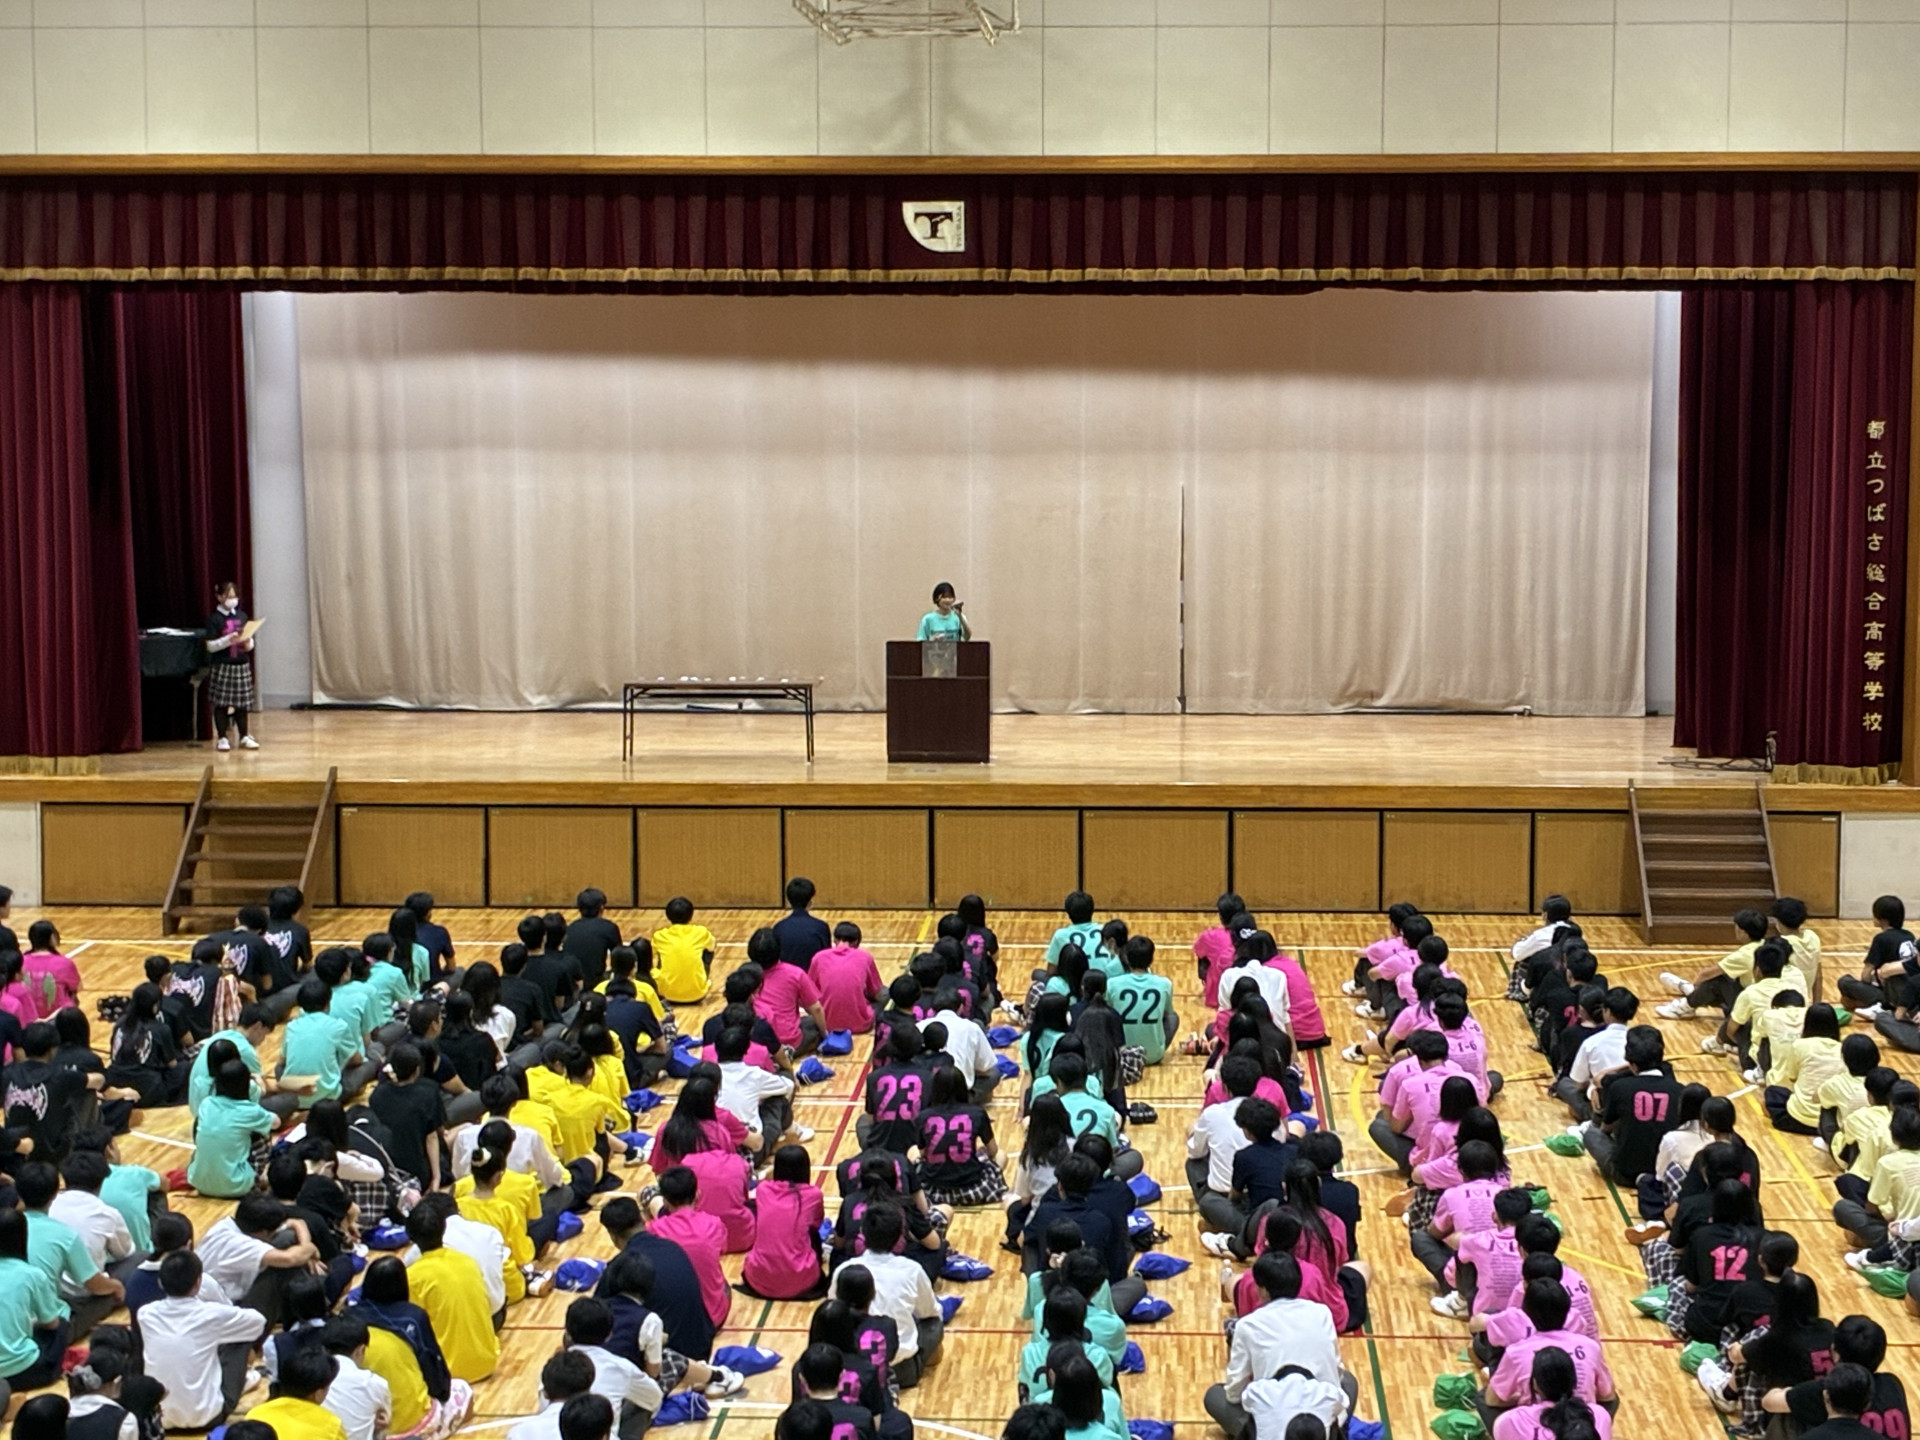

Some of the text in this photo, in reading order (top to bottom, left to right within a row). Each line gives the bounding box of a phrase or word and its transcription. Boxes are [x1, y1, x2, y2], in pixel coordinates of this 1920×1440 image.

[1862, 420, 1887, 732] 都立つばさ総合高等学校
[1119, 989, 1162, 1025] 22
[876, 1074, 923, 1121] 23
[1633, 1091, 1670, 1122] 07
[925, 1113, 973, 1164] 23
[1710, 1245, 1749, 1281] 12
